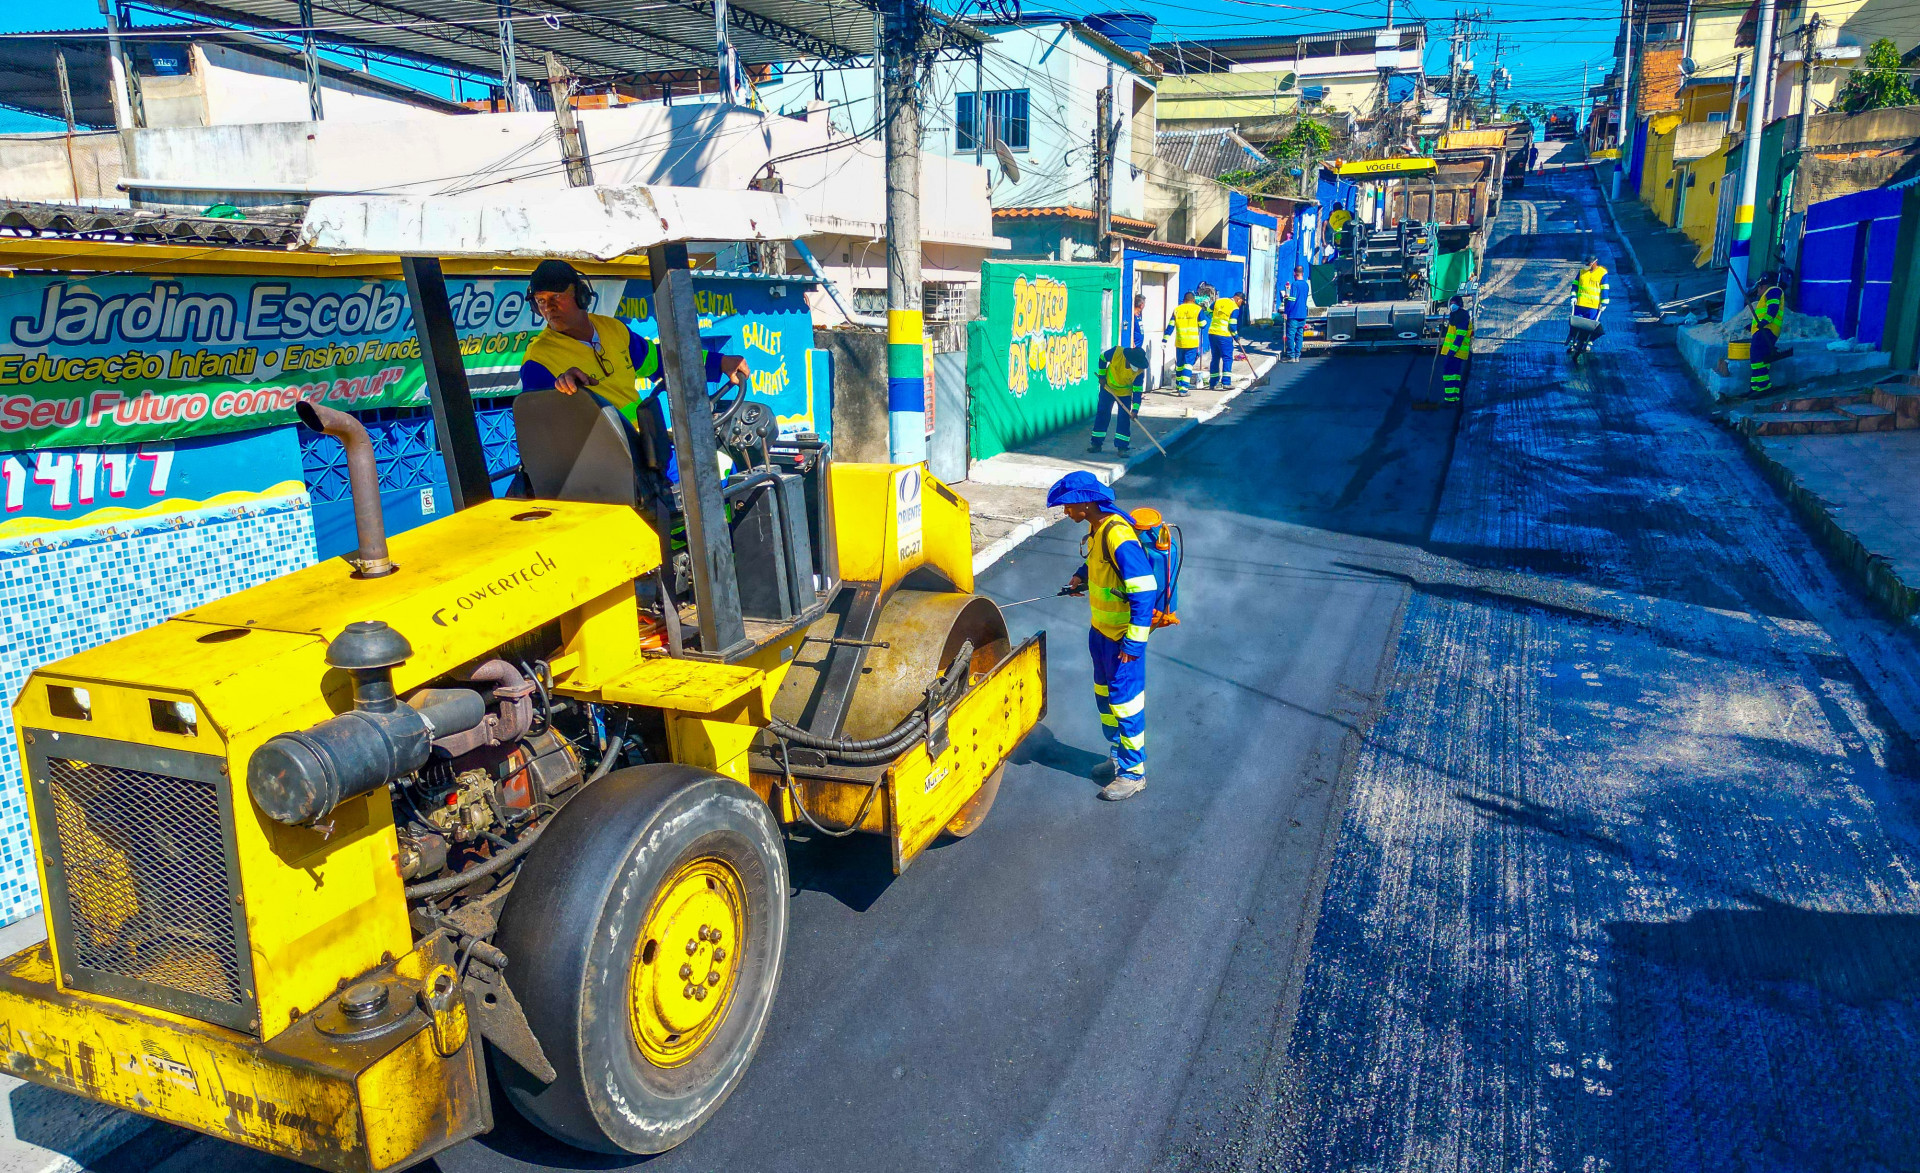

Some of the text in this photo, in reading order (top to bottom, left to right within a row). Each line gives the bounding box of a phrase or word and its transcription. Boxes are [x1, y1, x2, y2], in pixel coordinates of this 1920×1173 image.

[1366, 162, 1401, 171] VÖGELE
[11, 281, 237, 346] Jardim
[244, 282, 404, 340] Escola
[403, 283, 494, 333] rte
[495, 291, 524, 328] e
[616, 296, 648, 319] SINO
[1012, 274, 1068, 339] BOTECO
[0, 350, 163, 384] Educação
[167, 346, 257, 379] Infantil
[281, 341, 358, 371] Ensino
[485, 332, 509, 354] do
[742, 321, 782, 356] BALLET
[1009, 341, 1028, 394] DA
[88, 390, 208, 426] Futuro
[213, 382, 328, 417] começa
[898, 504, 921, 525] ORIENTE
